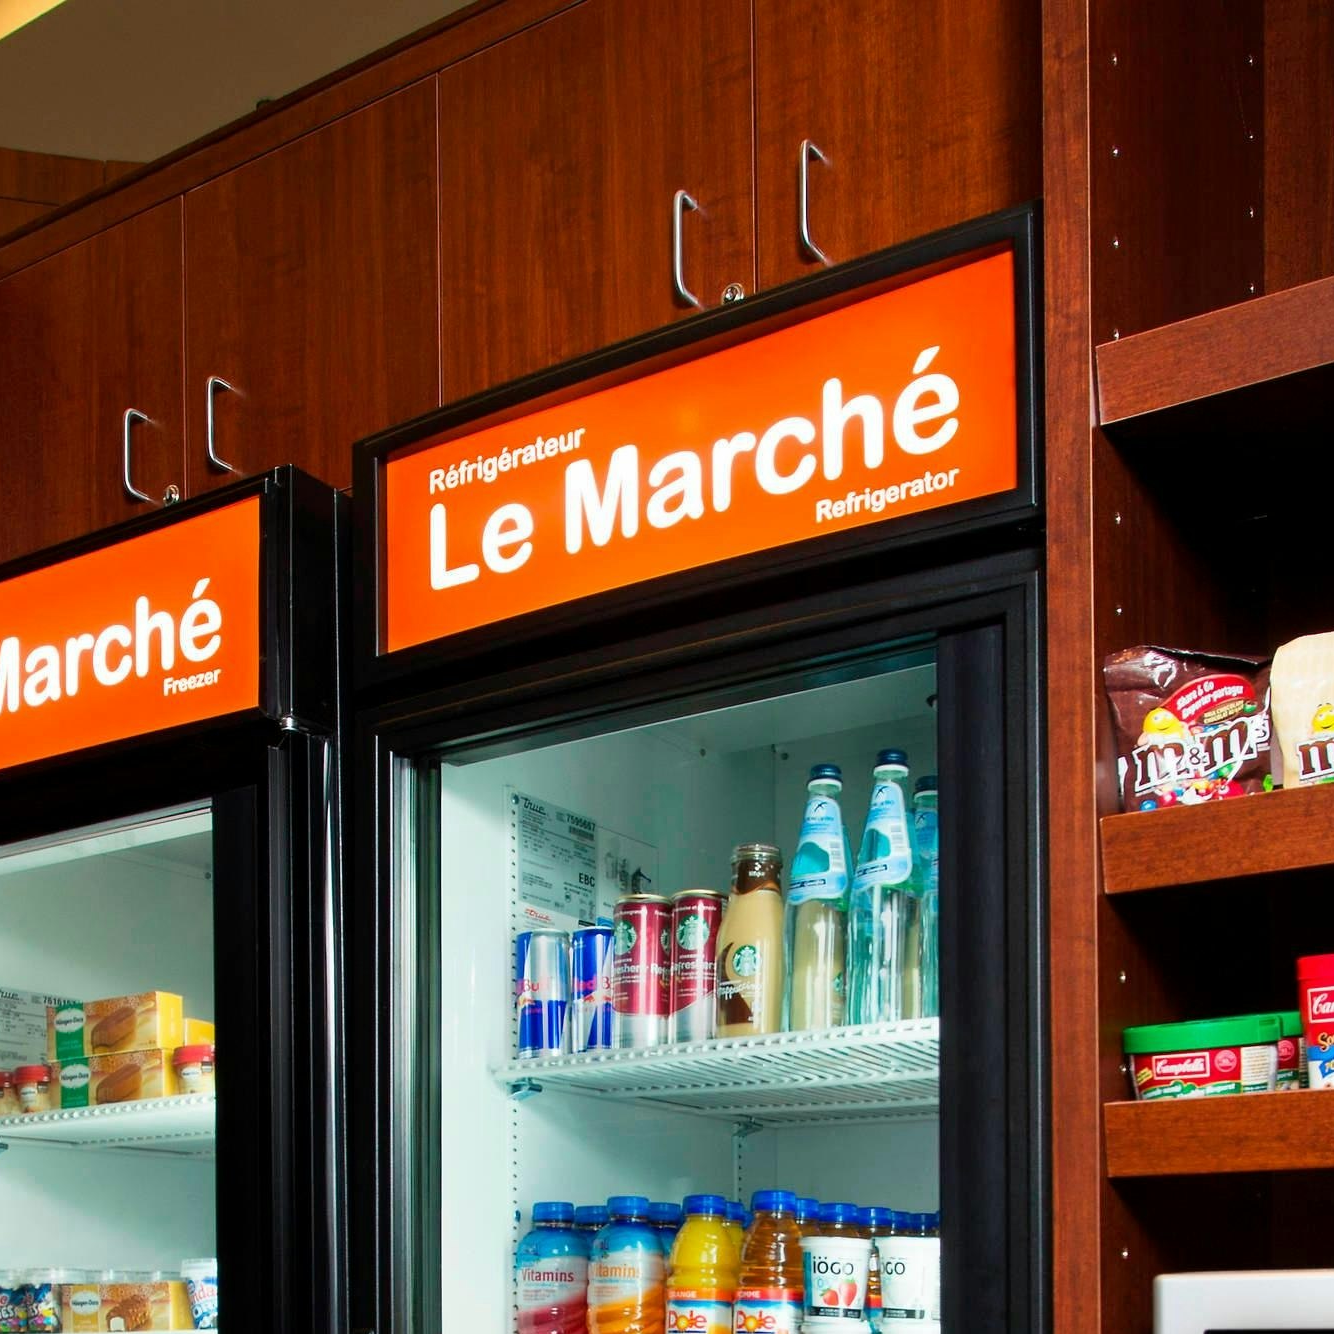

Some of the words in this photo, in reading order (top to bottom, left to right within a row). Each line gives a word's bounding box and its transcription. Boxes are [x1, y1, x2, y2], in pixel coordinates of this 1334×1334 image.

[429, 427, 585, 495] Réfrigérateur
[429, 500, 534, 591] Le
[565, 346, 961, 554] Marché
[816, 465, 960, 523] Refrigerator
[163, 668, 221, 696] Freezer
[668, 1310, 707, 1330] Dole
[736, 1310, 776, 1330] Dole
